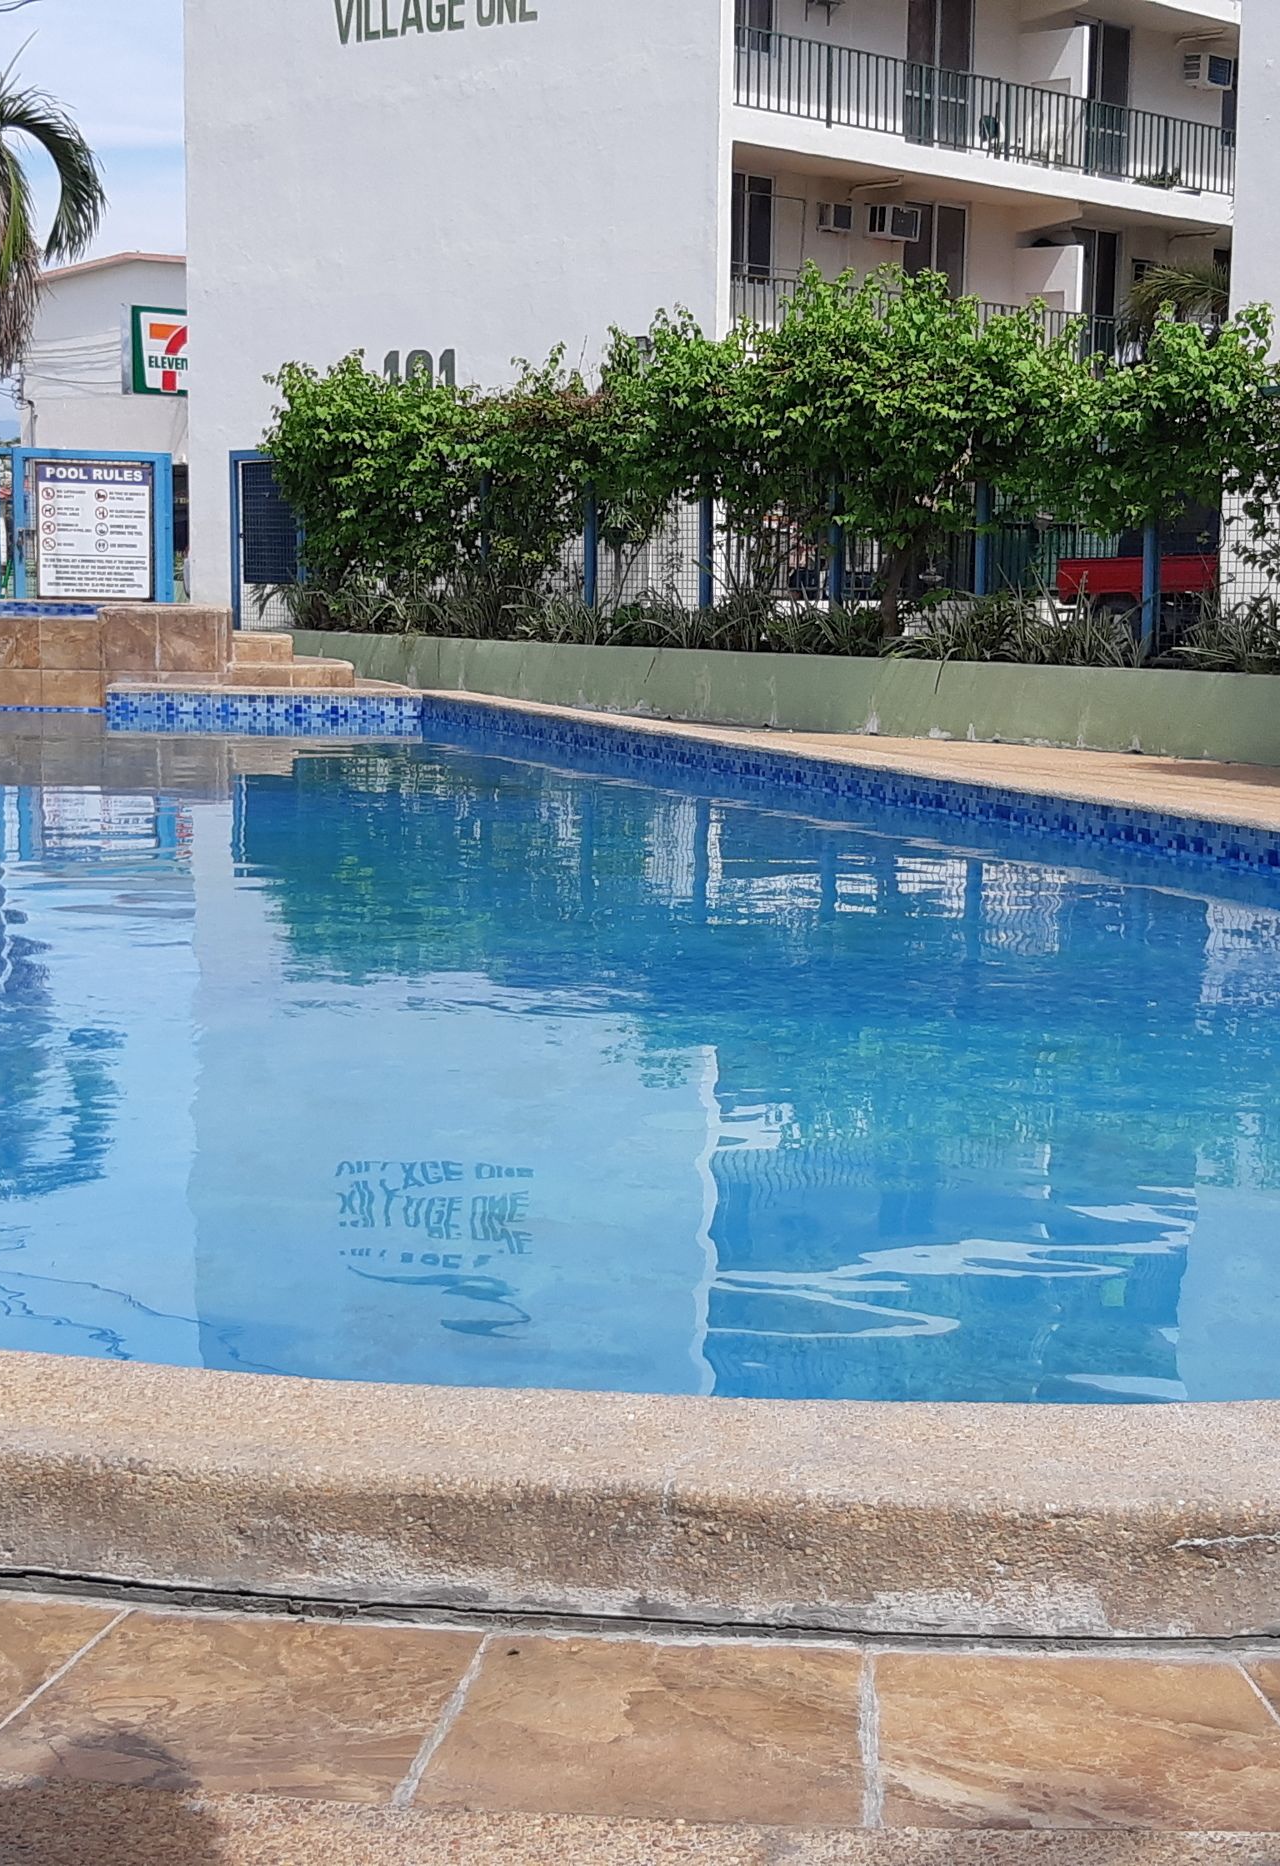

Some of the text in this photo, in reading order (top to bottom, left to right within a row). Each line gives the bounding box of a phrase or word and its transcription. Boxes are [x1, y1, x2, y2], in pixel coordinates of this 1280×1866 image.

[334, 0, 465, 44] VILLAGE
[149, 323, 188, 391] 7
[45, 467, 143, 482] POOL RULES
